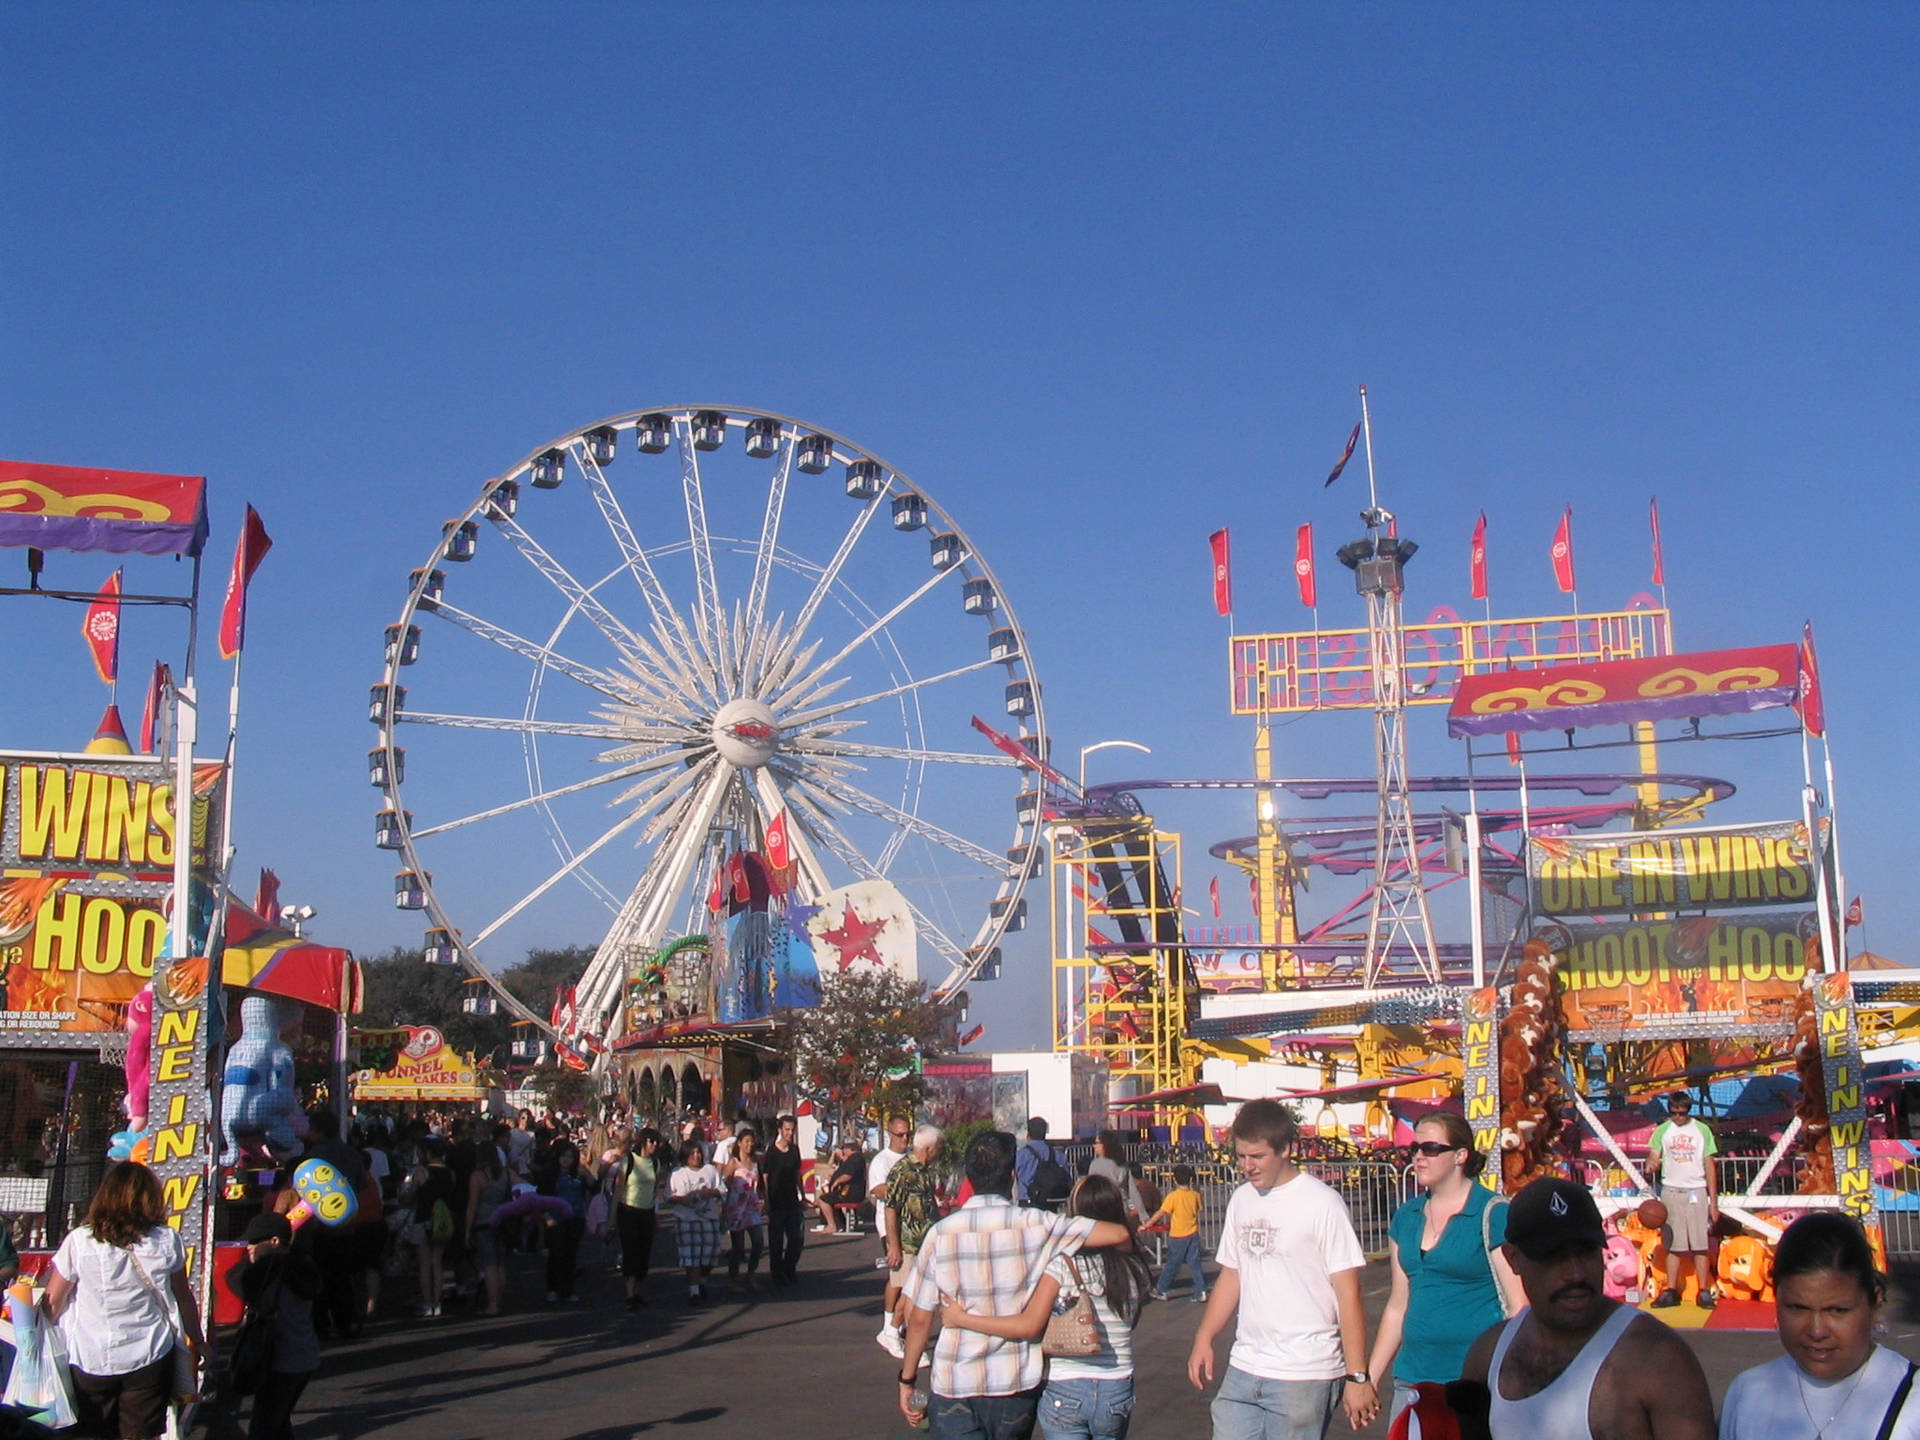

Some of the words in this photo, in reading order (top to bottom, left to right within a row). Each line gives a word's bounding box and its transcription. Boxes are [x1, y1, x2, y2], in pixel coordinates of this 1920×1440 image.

[1540, 846, 1624, 912] ONE
[1629, 839, 1675, 905] IN
[7, 1020, 18, 1029] OR
[19, 1021, 61, 1030] REBOUNDS
[21, 1011, 38, 1020] SIZE
[39, 1011, 50, 1020] OR
[51, 1011, 77, 1021] SHAPE
[374, 1057, 443, 1079] UNNEL
[413, 1070, 458, 1084] CAKES
[1830, 1066, 1858, 1113] IN
[1468, 1075, 1495, 1120] IN
[153, 1094, 199, 1163] IN
[1829, 1119, 1871, 1219] WINS
